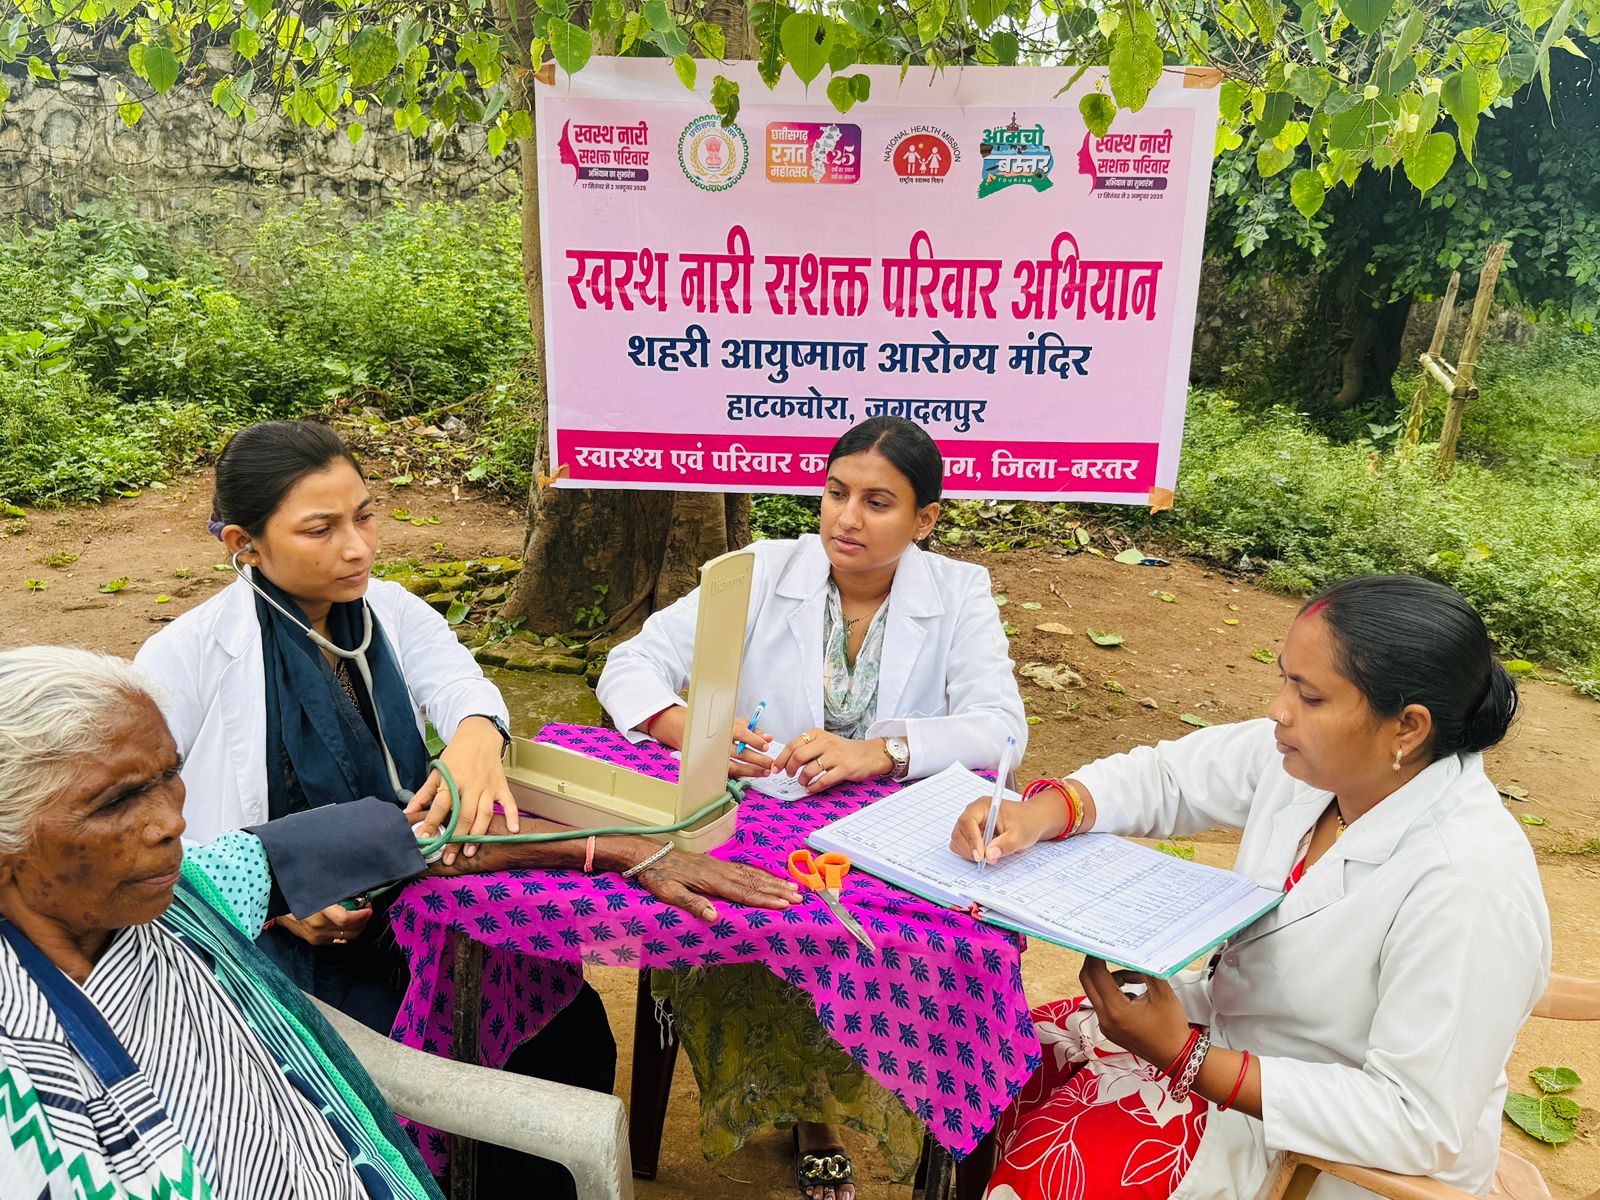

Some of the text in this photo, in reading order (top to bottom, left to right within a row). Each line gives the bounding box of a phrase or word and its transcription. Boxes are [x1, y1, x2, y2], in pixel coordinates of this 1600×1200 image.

[573, 120, 648, 146] स्वस्थ नारी
[884, 126, 962, 162] NATIONAL HEALTH MISSION
[1096, 128, 1173, 153] स्वस्थ नारी
[578, 146, 649, 166] सशक्त परिवार
[770, 144, 808, 164] रजत
[832, 145, 855, 166] 25
[1098, 155, 1170, 174] सशक्त परिवार
[770, 162, 808, 178] महोत्सव
[566, 224, 1163, 321] स्वस्थ नारी सशक्त परिवार अभियान
[628, 324, 1092, 384] शहरी आयुष्मान आरोग्य मंदिर
[726, 386, 988, 433] हाटकचोरा, जगदलपुर
[574, 446, 664, 470] स्वास्थ्य
[670, 442, 704, 474] एवं
[711, 443, 792, 474] परिवार
[991, 449, 1140, 480] जिला-बस्तर
